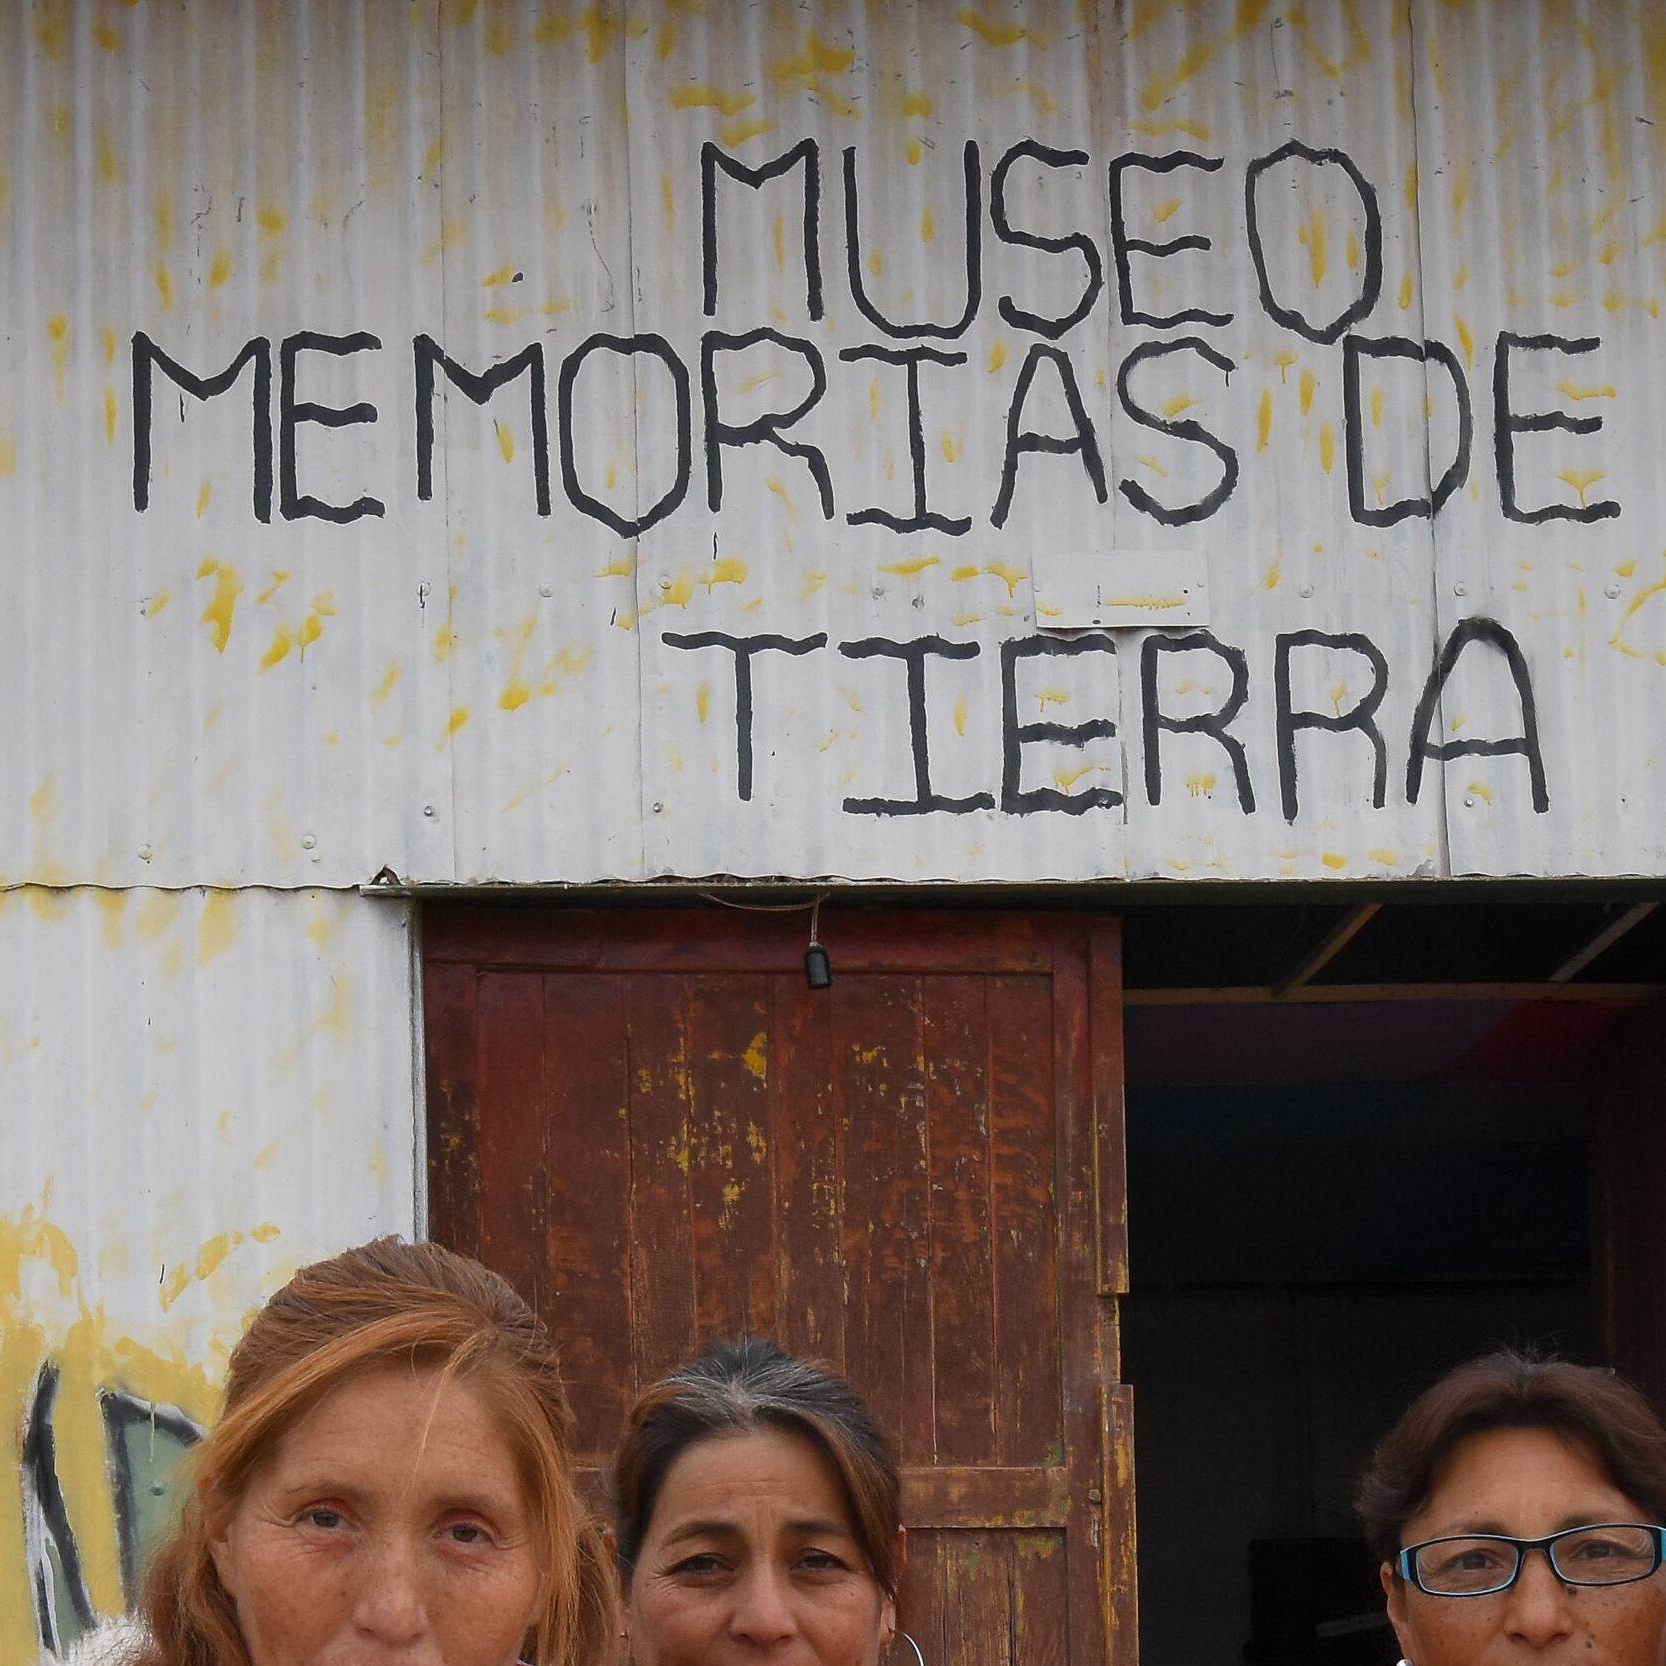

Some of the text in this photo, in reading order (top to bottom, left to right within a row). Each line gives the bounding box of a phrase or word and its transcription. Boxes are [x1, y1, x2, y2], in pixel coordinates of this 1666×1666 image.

[699, 136, 1384, 347] MUSEO
[129, 326, 1240, 542] MEMORIAS
[1342, 330, 1623, 528] DE
[660, 616, 1551, 822] TIERRA
